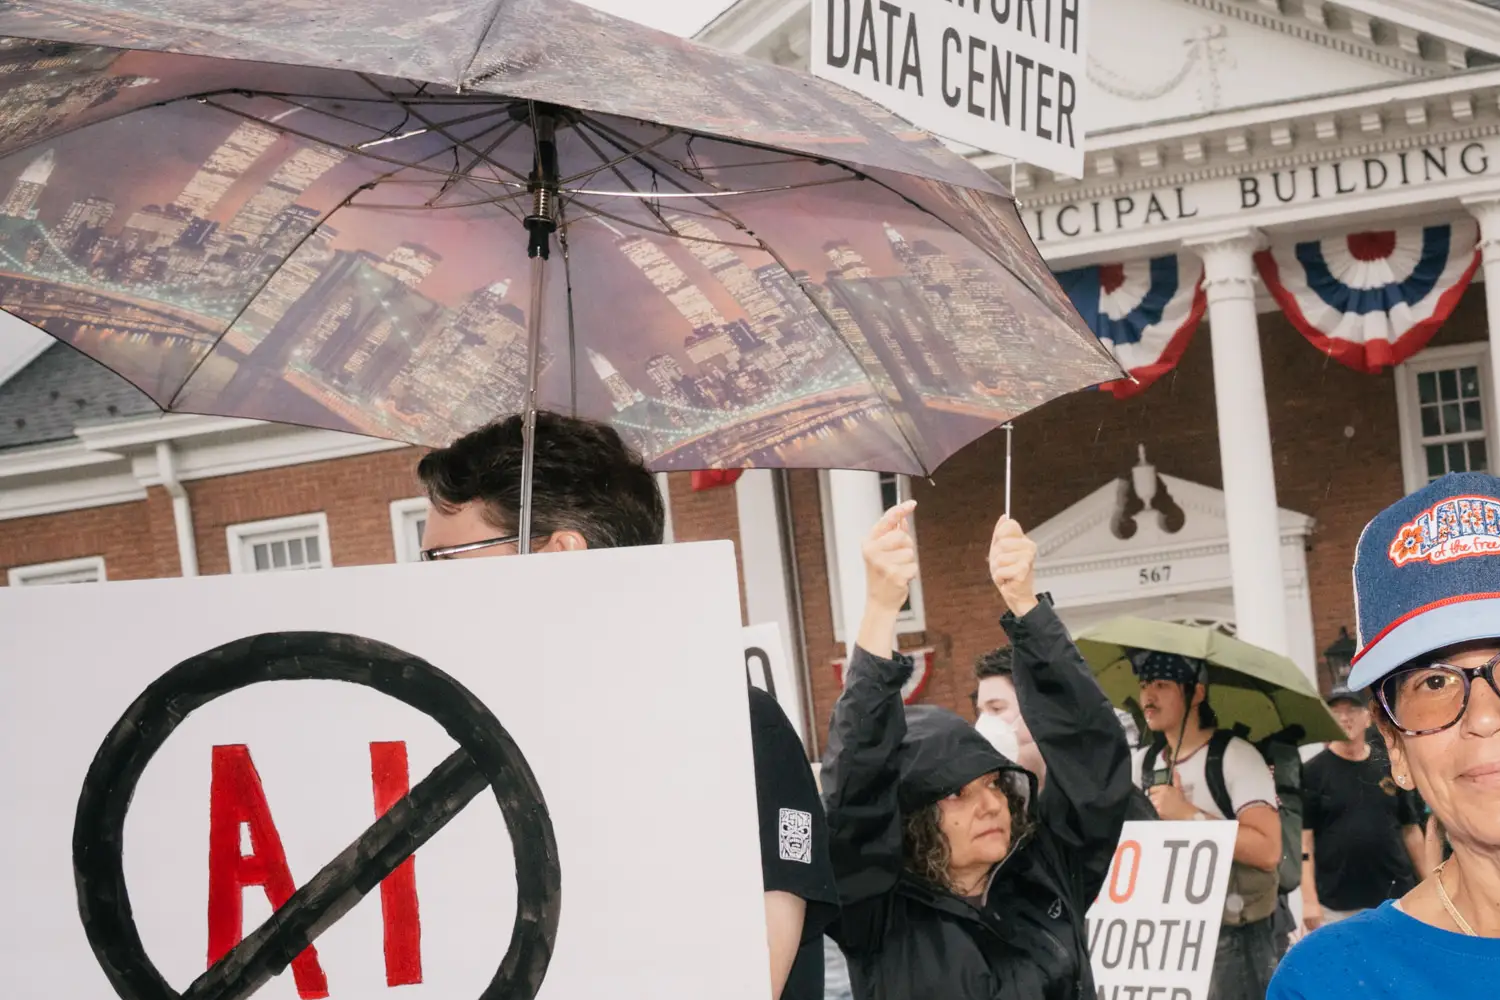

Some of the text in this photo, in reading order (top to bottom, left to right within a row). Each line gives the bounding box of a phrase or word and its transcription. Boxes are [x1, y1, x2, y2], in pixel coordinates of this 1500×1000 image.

[826, 0, 924, 97] DATA
[941, 26, 1076, 149] CENTER
[1237, 142, 1490, 210] BUILDING
[1138, 565, 1172, 585] 567
[1434, 541, 1446, 559] of
[1450, 539, 1471, 554] the
[206, 740, 423, 1000] AI
[1094, 839, 1219, 905] O TO
